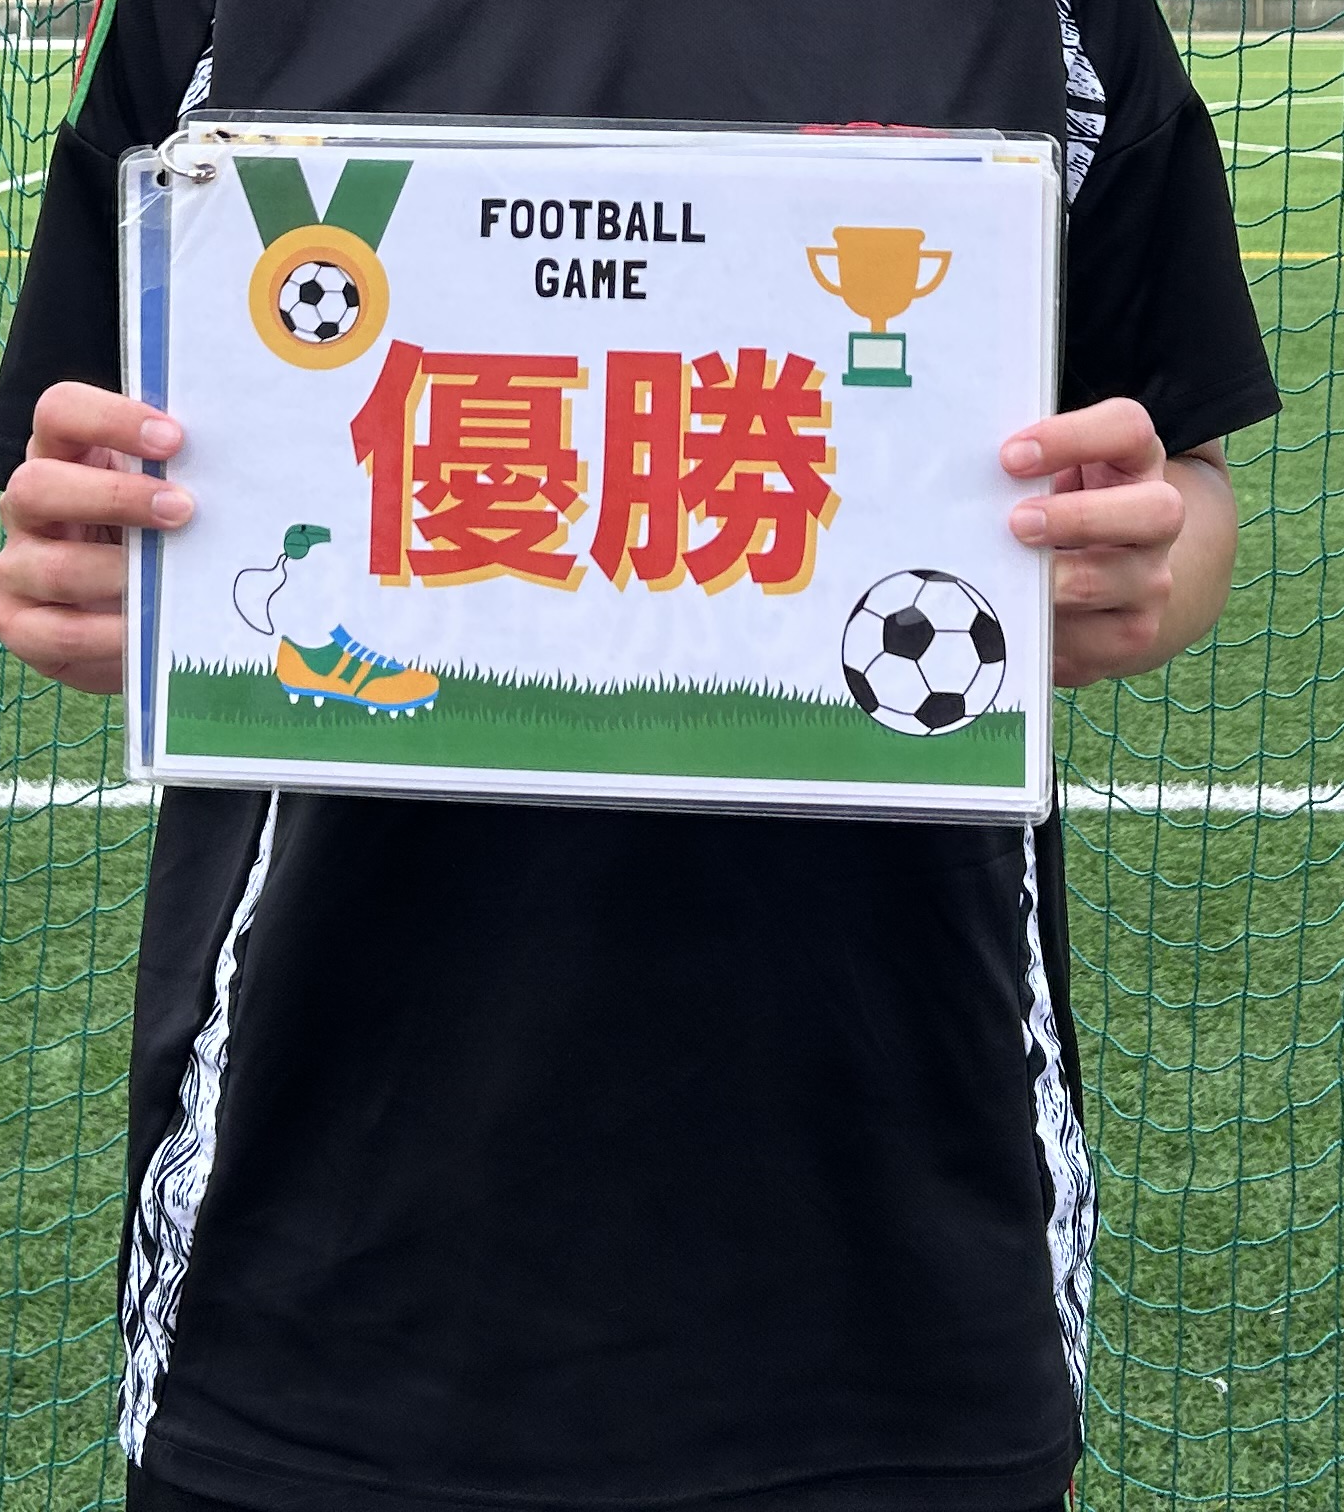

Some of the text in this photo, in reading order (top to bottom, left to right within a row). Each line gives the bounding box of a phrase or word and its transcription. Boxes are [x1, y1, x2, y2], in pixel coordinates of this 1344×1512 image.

[480, 198, 706, 243] FOOTBALL
[534, 257, 648, 300] GAME
[350, 340, 836, 592] 優勝
